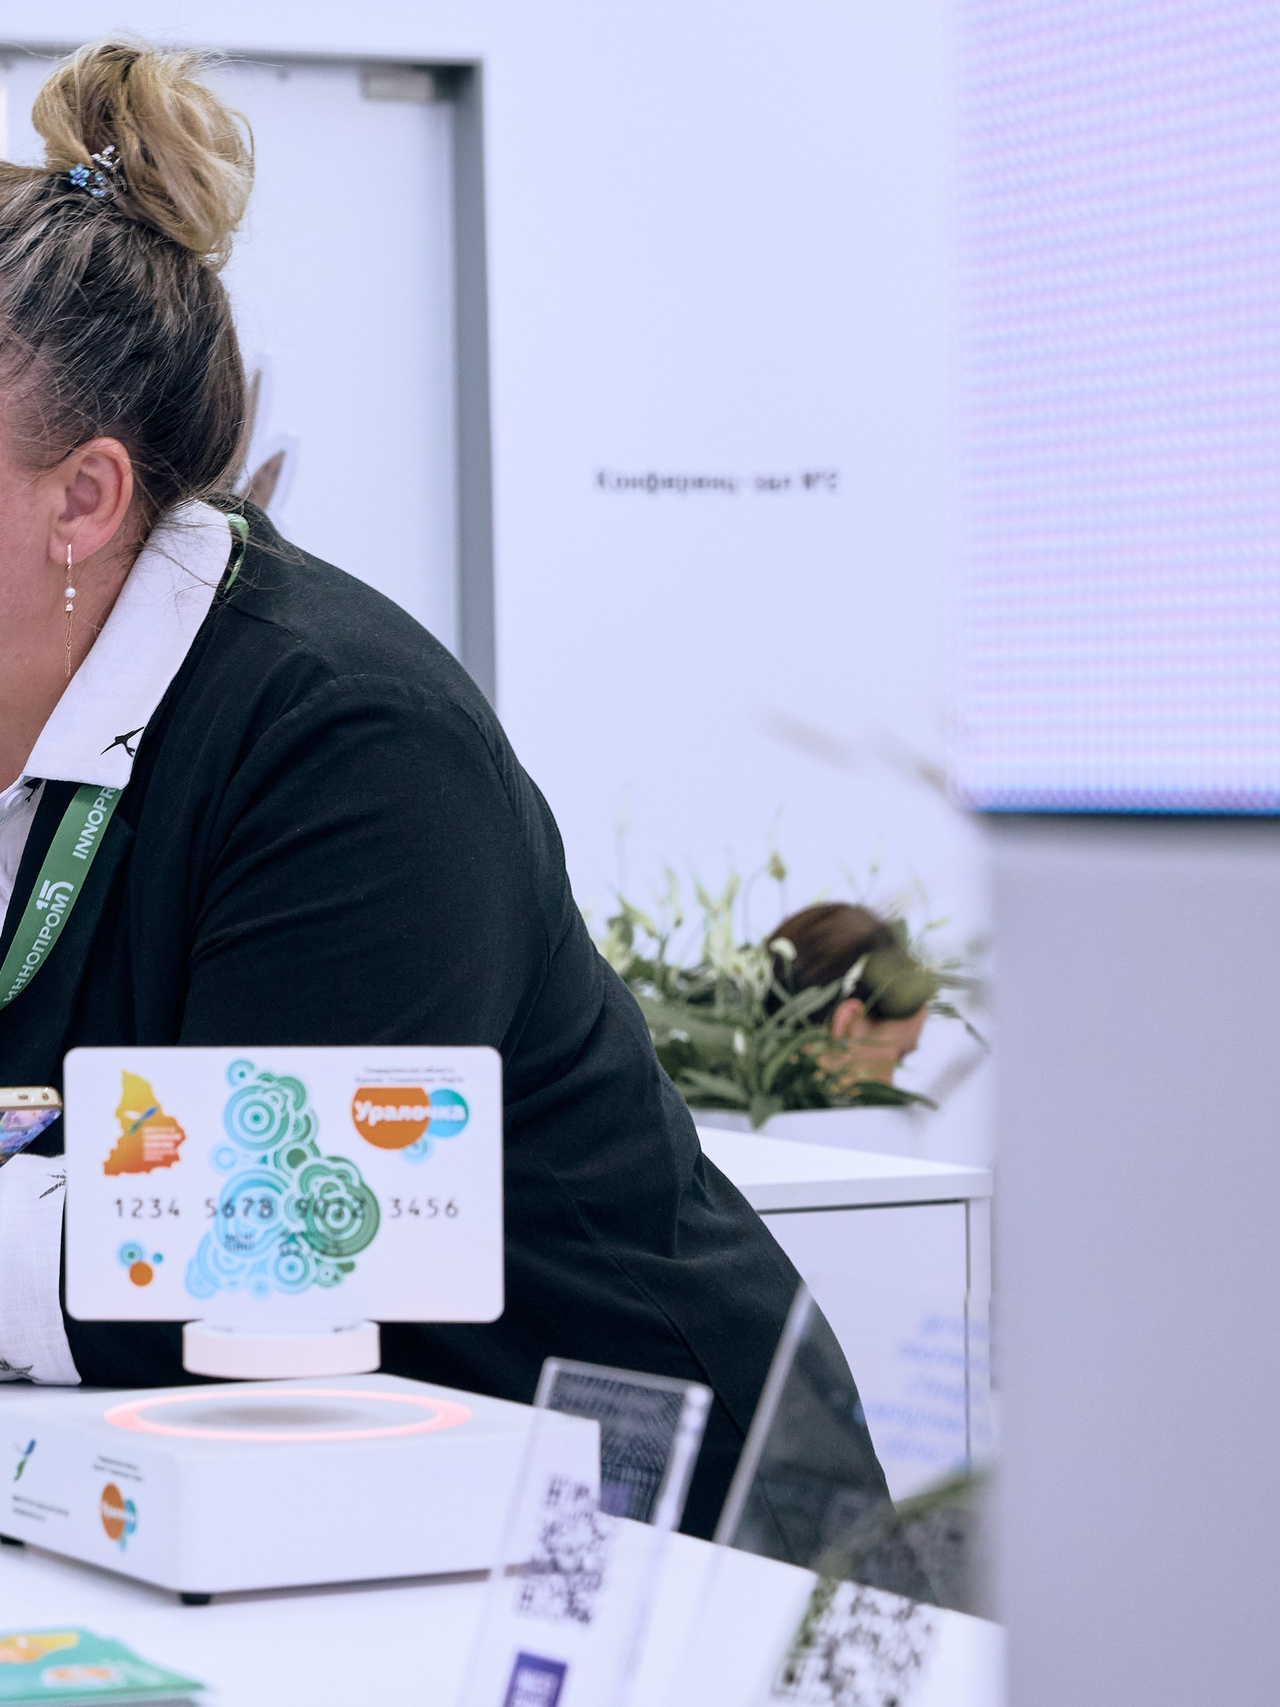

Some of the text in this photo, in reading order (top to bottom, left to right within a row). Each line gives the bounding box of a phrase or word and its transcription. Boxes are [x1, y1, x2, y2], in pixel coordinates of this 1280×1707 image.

[36, 880, 74, 910] 15
[3, 893, 70, 1002] ИННОПРОМ
[354, 1100, 466, 1127] Уралочка
[115, 1198, 180, 1218] 1234
[204, 1198, 274, 1219] 5678
[389, 1198, 459, 1218] 3456
